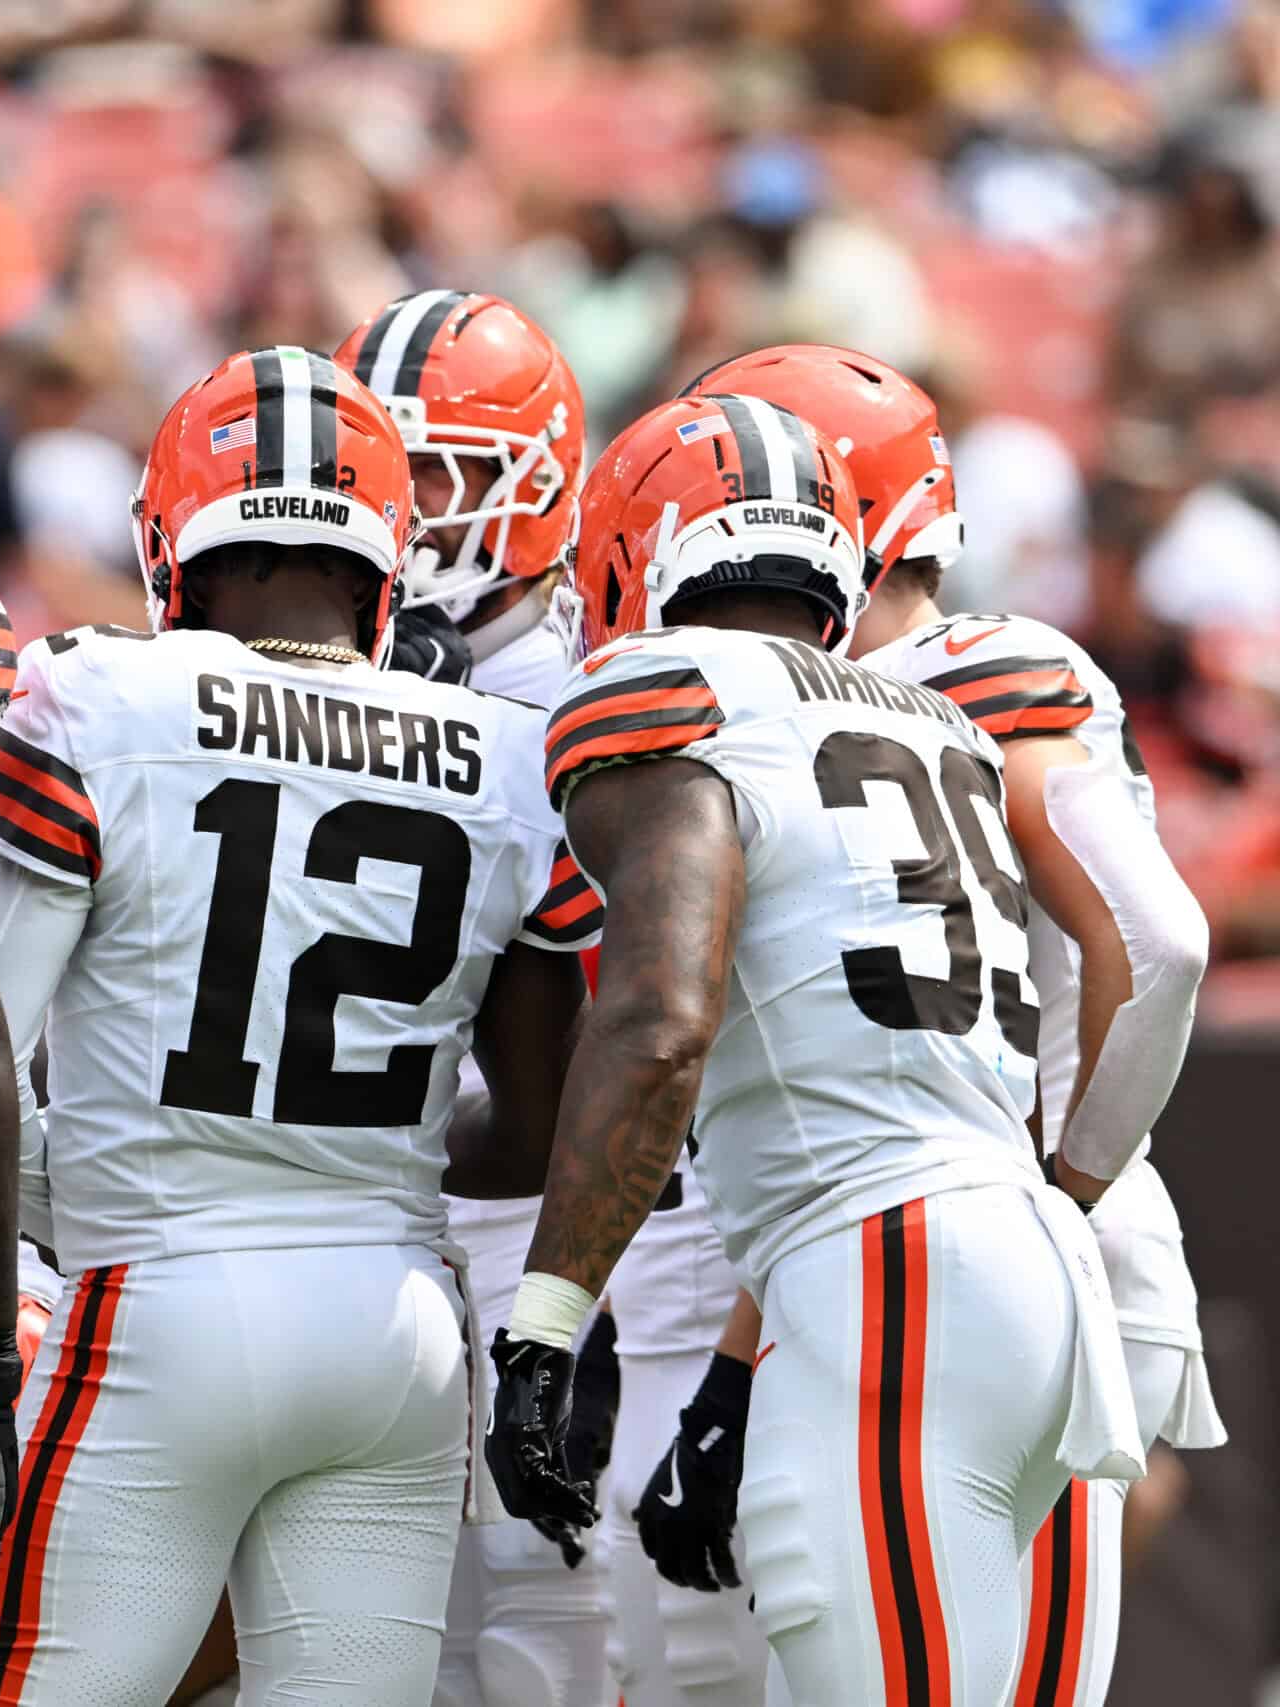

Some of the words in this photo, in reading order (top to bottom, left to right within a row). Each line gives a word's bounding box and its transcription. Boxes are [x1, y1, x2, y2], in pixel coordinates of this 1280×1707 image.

[240, 496, 350, 527] CLEVELAND
[743, 507, 826, 534] CLEVELAND
[197, 673, 482, 796] SANDERS
[159, 777, 472, 1128] 12
[813, 730, 1041, 1061] 39
